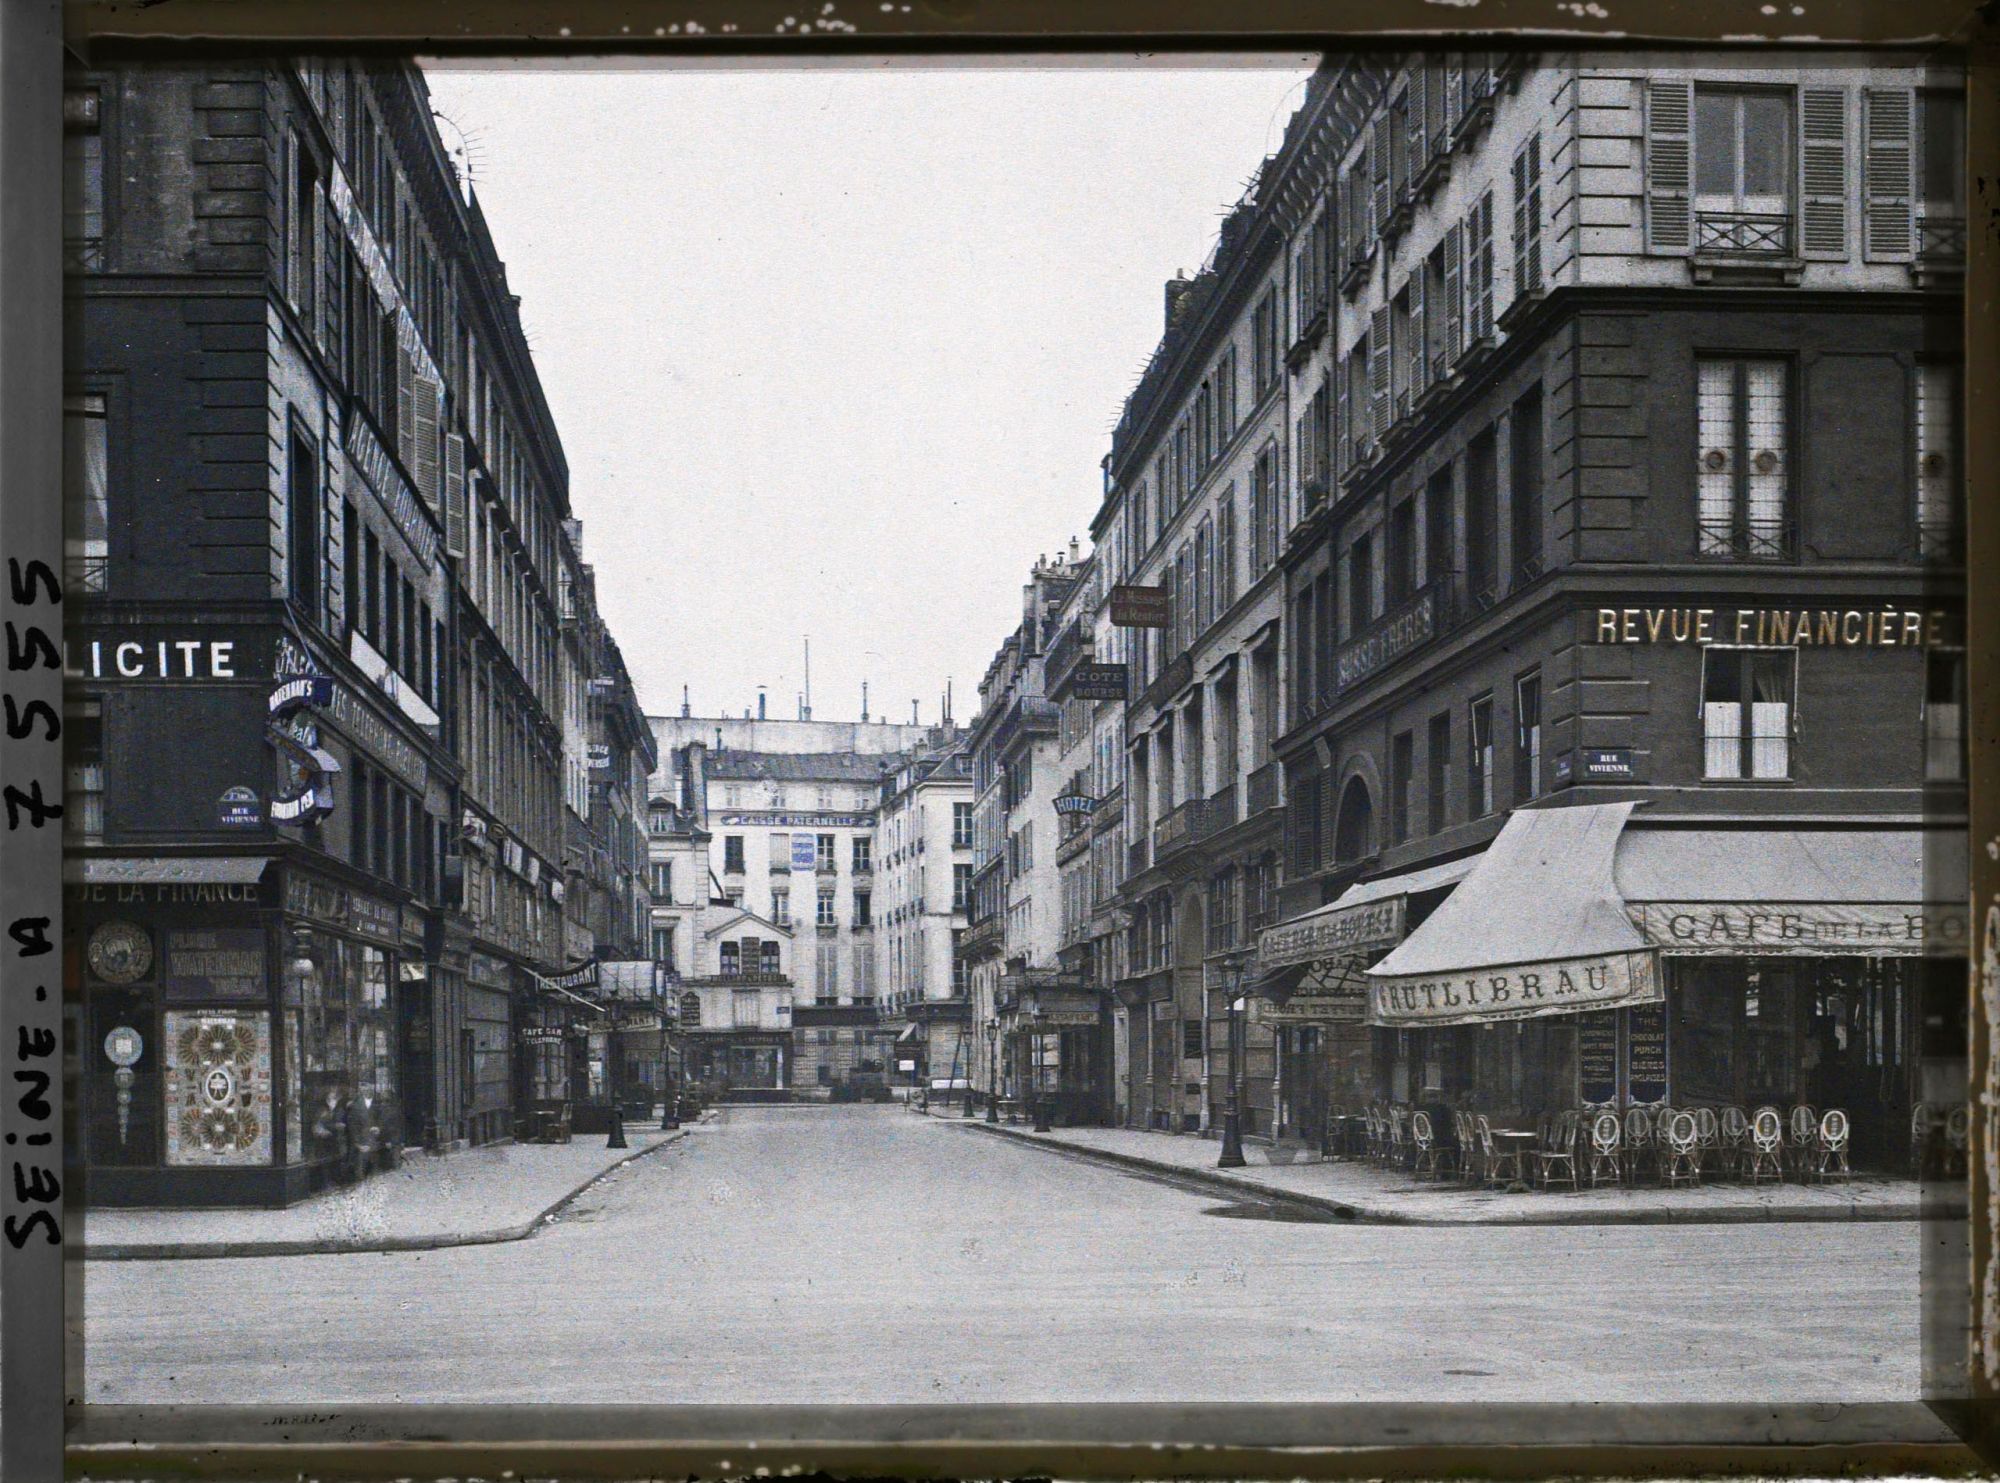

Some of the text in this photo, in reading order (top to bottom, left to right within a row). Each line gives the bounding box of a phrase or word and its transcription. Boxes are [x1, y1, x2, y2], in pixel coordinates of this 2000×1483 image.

[1598, 604, 1944, 645] REVUE FINANCIÈRE
[1600, 754, 1617, 762] RUE
[1589, 764, 1629, 772] VIVIENNE
[1056, 796, 1093, 814] HOTEL
[222, 815, 259, 823] VIVIENNE
[740, 815, 856, 827] CAISSE PATERNELLE
[117, 885, 145, 902] LA
[156, 885, 258, 903] FINANCE
[538, 962, 597, 991] RESTAURANT
[1631, 1033, 1665, 1041] CHOCOLAT
[1634, 1046, 1662, 1055] PUNCH
